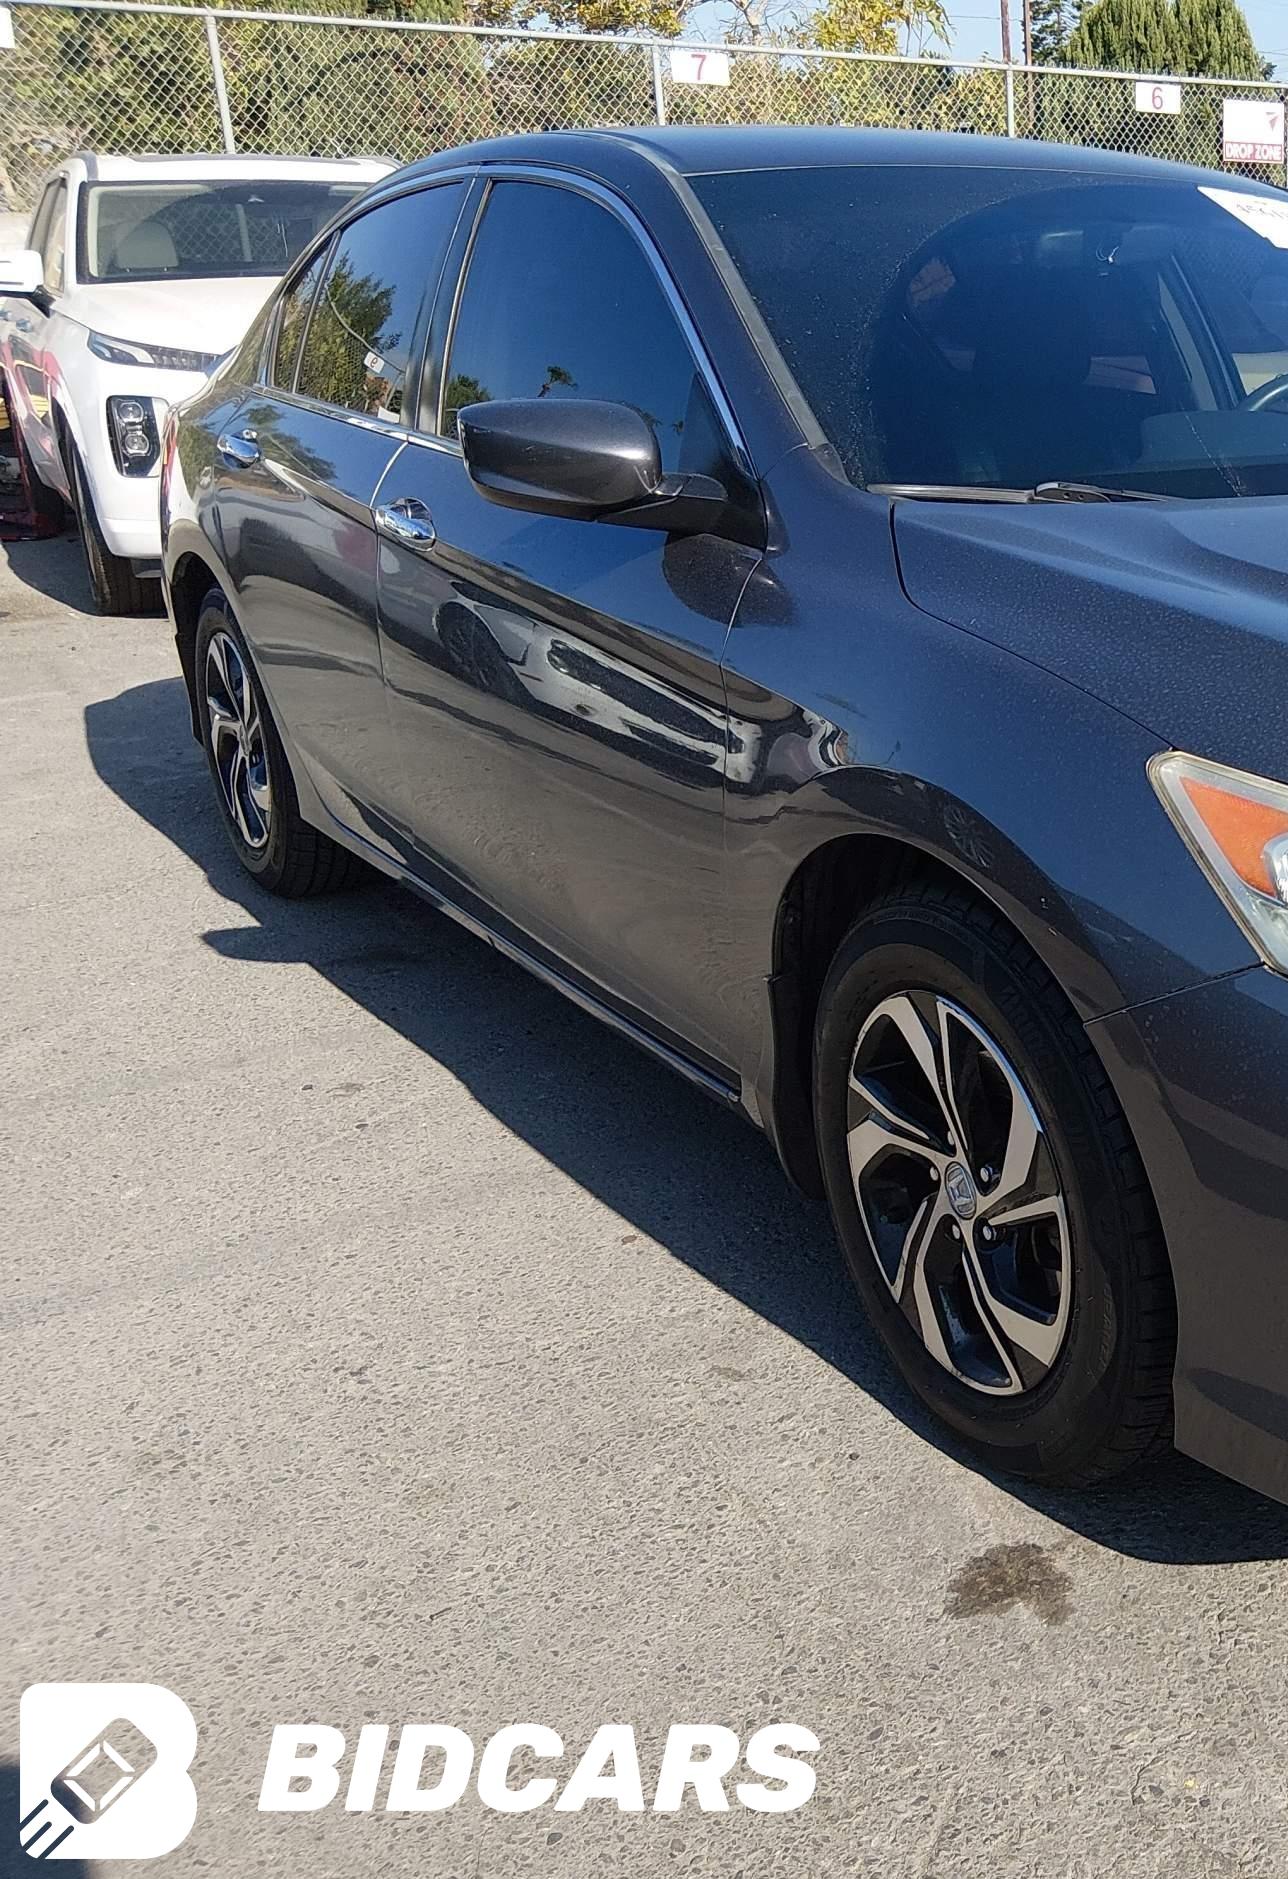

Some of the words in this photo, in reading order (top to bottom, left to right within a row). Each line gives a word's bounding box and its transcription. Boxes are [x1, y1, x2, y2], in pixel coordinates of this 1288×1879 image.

[691, 54, 706, 80] 7
[1152, 87, 1163, 110] 6
[1226, 143, 1253, 160] DROP
[1255, 144, 1281, 161] ZONE
